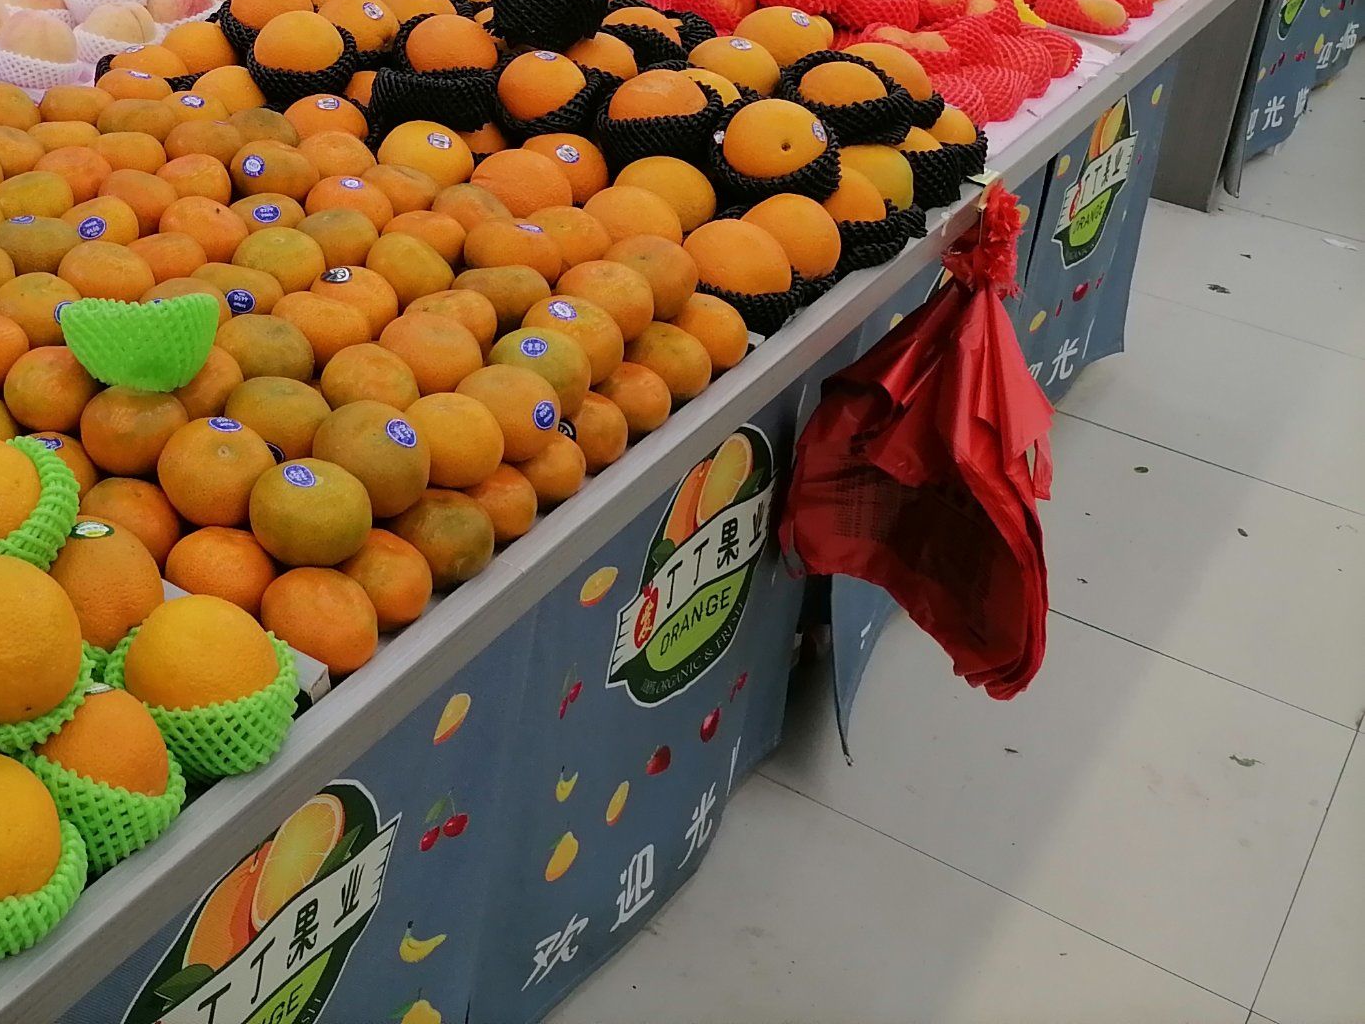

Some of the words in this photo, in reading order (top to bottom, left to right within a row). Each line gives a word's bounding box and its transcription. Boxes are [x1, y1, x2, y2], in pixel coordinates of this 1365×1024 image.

[665, 498, 767, 610] 丁丁果业
[659, 586, 732, 656] ORANGE
[197, 862, 368, 1024] 丁丁果业
